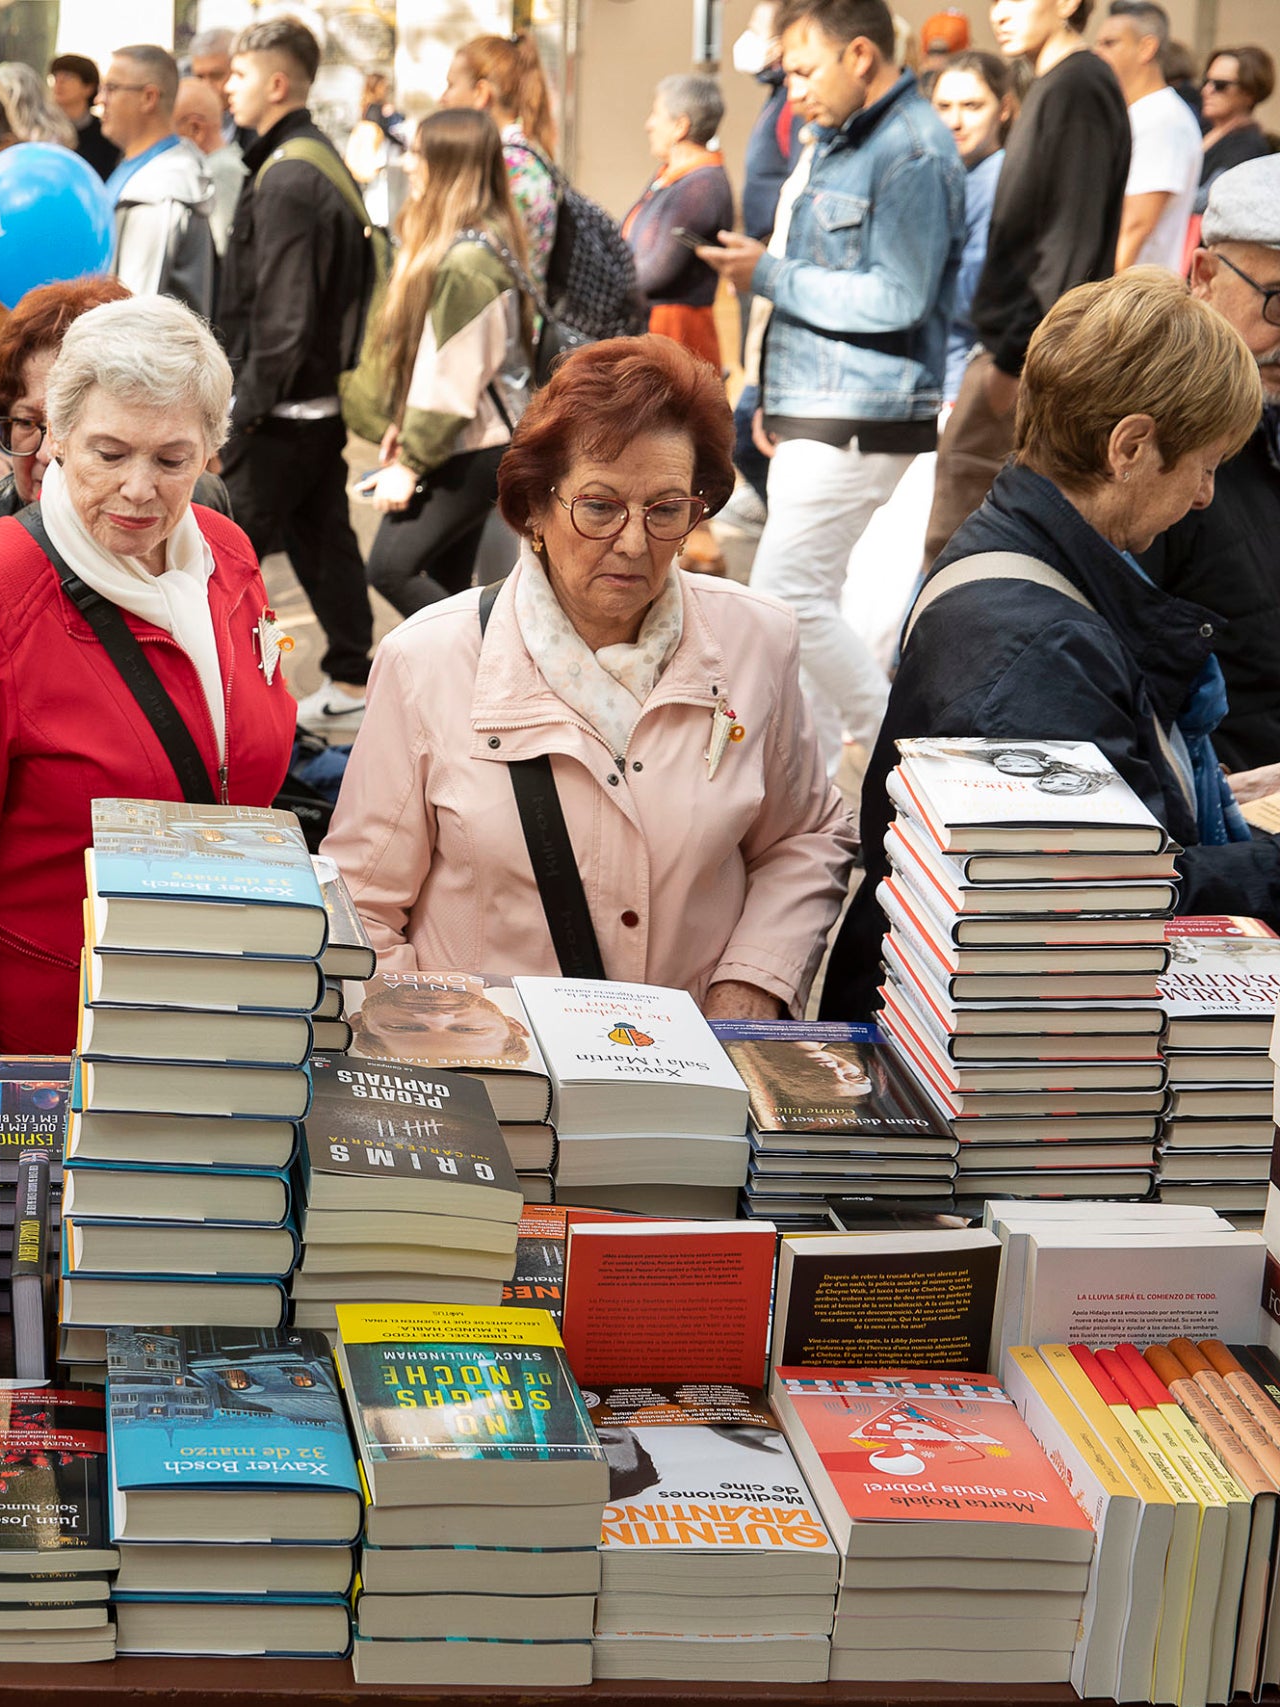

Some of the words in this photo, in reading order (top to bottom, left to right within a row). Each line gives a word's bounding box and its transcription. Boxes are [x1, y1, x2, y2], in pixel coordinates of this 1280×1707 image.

[142, 880, 211, 894] Bosch
[218, 883, 294, 897] Xavier
[383, 981, 419, 990] LA
[432, 982, 466, 991] EN
[1160, 988, 1241, 1005] ÉREM
[563, 1007, 622, 1018] sabana
[585, 1001, 628, 1011] Mart
[365, 1055, 428, 1064] HARRY
[438, 1058, 528, 1067] PRÍNCIPE
[576, 1054, 647, 1067] Martín
[653, 1058, 660, 1067] i
[667, 1058, 710, 1071] Sala
[614, 1065, 681, 1078] Xavier
[337, 1069, 450, 1097] CAPITALS
[351, 1084, 443, 1109] PECATS
[807, 1107, 856, 1116] Carme
[13, 1114, 36, 1123] FAS
[40, 1114, 58, 1123] EM
[771, 1114, 787, 1124] jo
[817, 1116, 838, 1126] de
[842, 1117, 881, 1127] deixi
[886, 1117, 929, 1127] Quan
[5, 1122, 27, 1132] EM
[32, 1122, 56, 1132] QUE
[328, 1136, 385, 1148] PORTA
[395, 1142, 463, 1158] CARLES
[329, 1144, 495, 1181] CRIMS
[824, 1273, 849, 1281] Després
[382, 1351, 486, 1361] WILLINGHAM
[494, 1351, 542, 1361] STACY
[380, 1365, 511, 1385] NOCHE
[523, 1372, 553, 1385] DE
[396, 1389, 551, 1410] SALGAS
[457, 1414, 508, 1435] NO
[180, 1447, 255, 1457] marzo
[263, 1447, 290, 1460] de
[296, 1447, 326, 1460] 32
[163, 1461, 240, 1474] Bosch
[245, 1461, 330, 1476] Xavier
[719, 1482, 765, 1493] cine
[772, 1485, 799, 1495] de
[863, 1480, 936, 1496] pobre!
[941, 1482, 1008, 1499] siguis
[658, 1490, 805, 1506] Meditaciones
[889, 1495, 961, 1509] Rojals
[1013, 1489, 1048, 1503] No
[44, 1504, 78, 1513] Solo
[964, 1498, 1035, 1514] Marta
[36, 1515, 80, 1528] Juan
[601, 1504, 822, 1528] TARANTINO
[601, 1522, 828, 1548] QUENTIN
